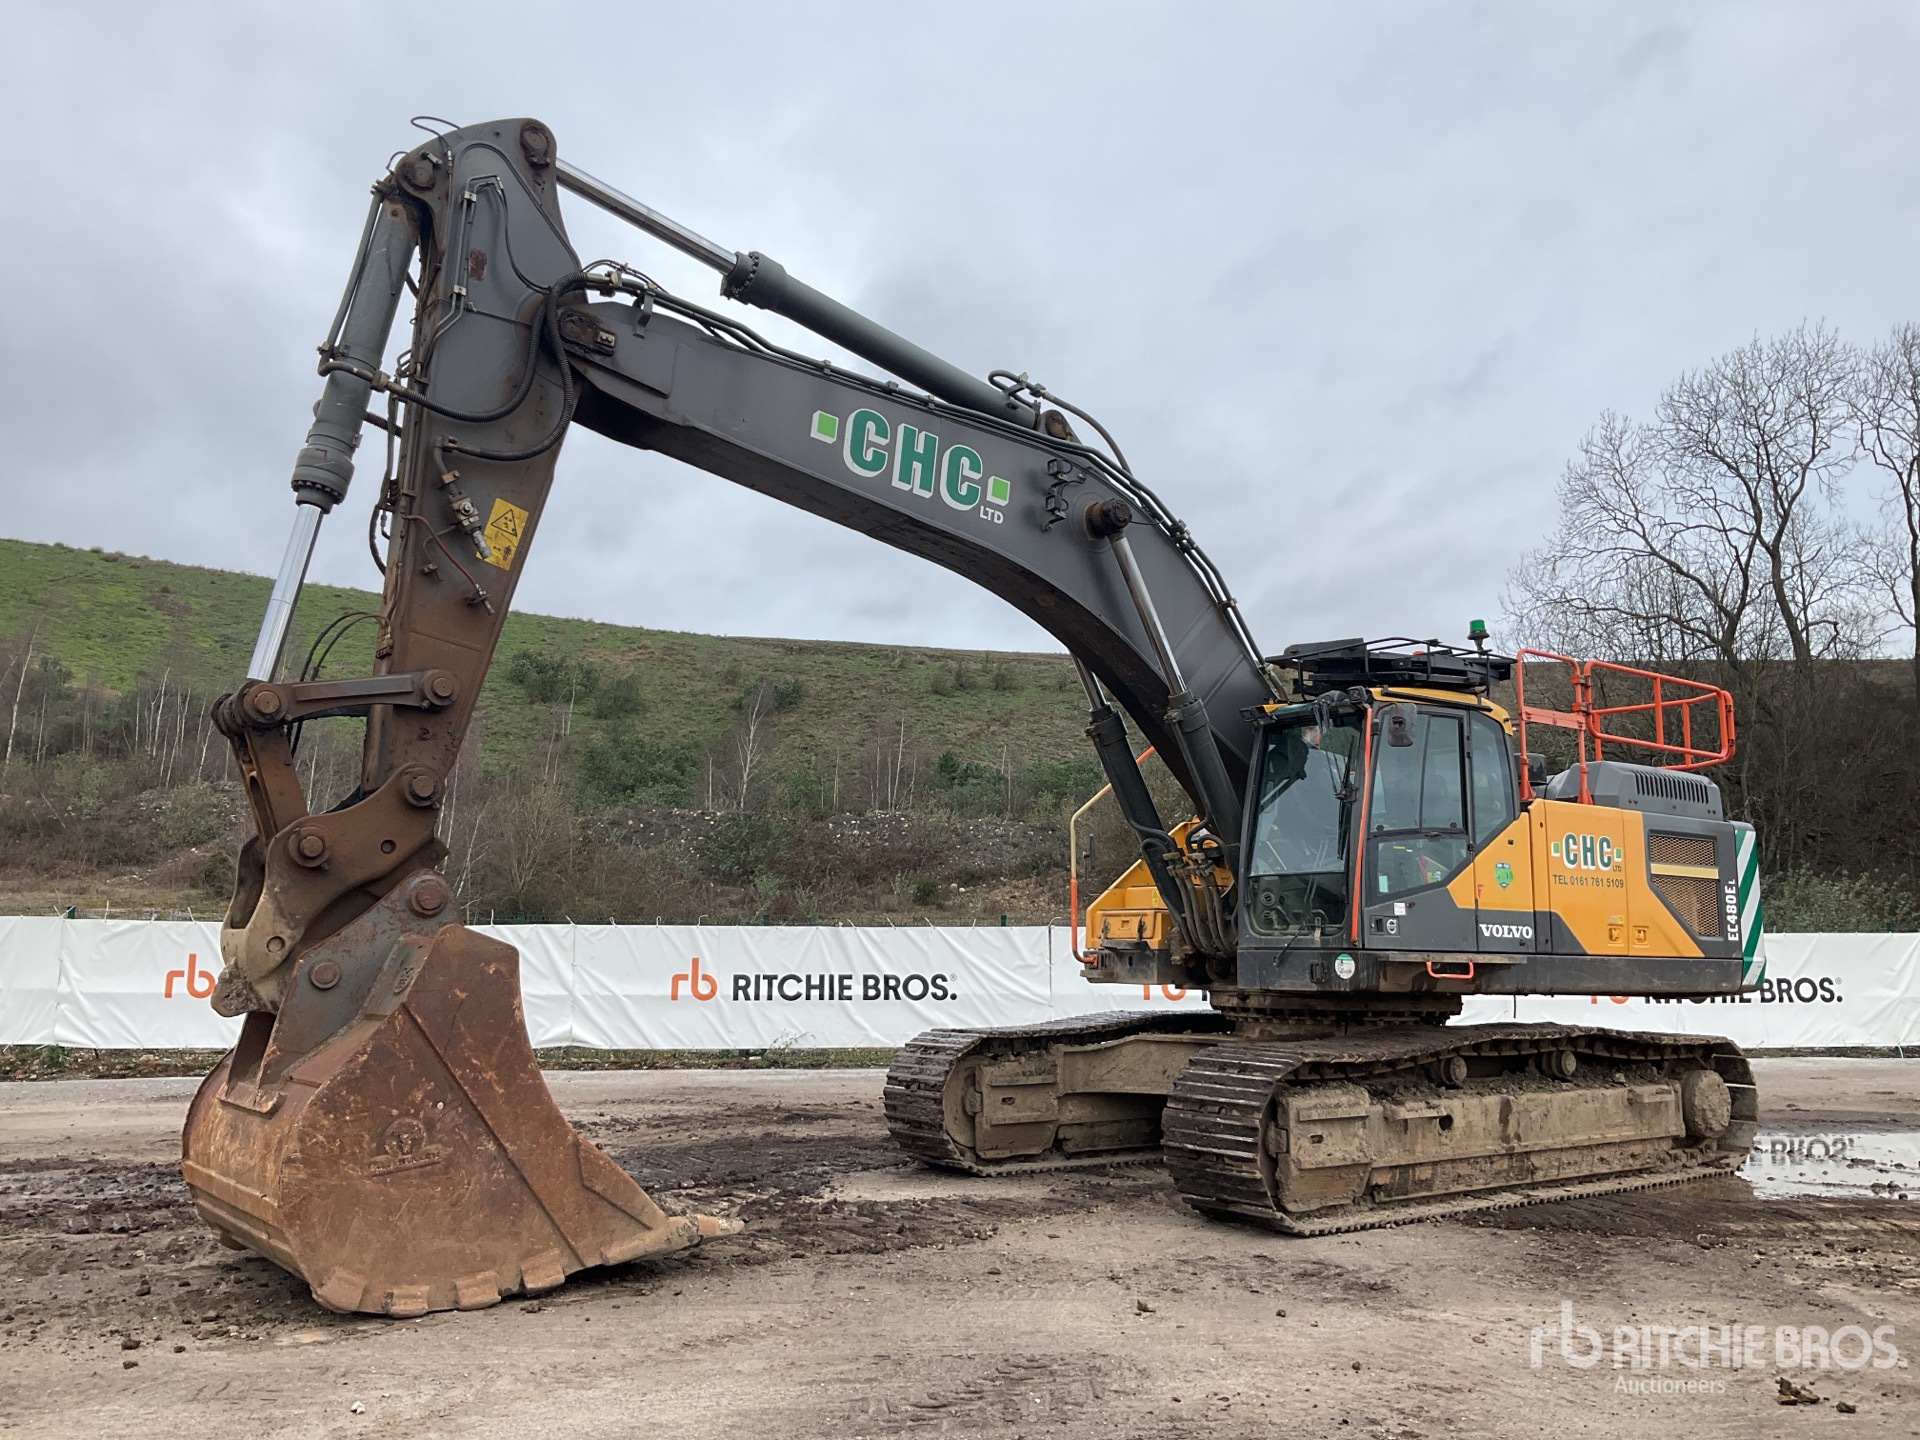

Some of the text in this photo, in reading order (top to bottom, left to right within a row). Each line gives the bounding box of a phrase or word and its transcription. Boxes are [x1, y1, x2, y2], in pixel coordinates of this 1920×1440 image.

[843, 408, 983, 511] CHC
[979, 505, 1004, 525] LTD
[1562, 832, 1612, 871] CHC
[1553, 874, 1624, 888] TEL 0161 761 5109
[1479, 924, 1533, 939] VOLVO
[732, 973, 957, 1001] RITCHIE BROS.
[1760, 977, 1843, 1003] BROS.
